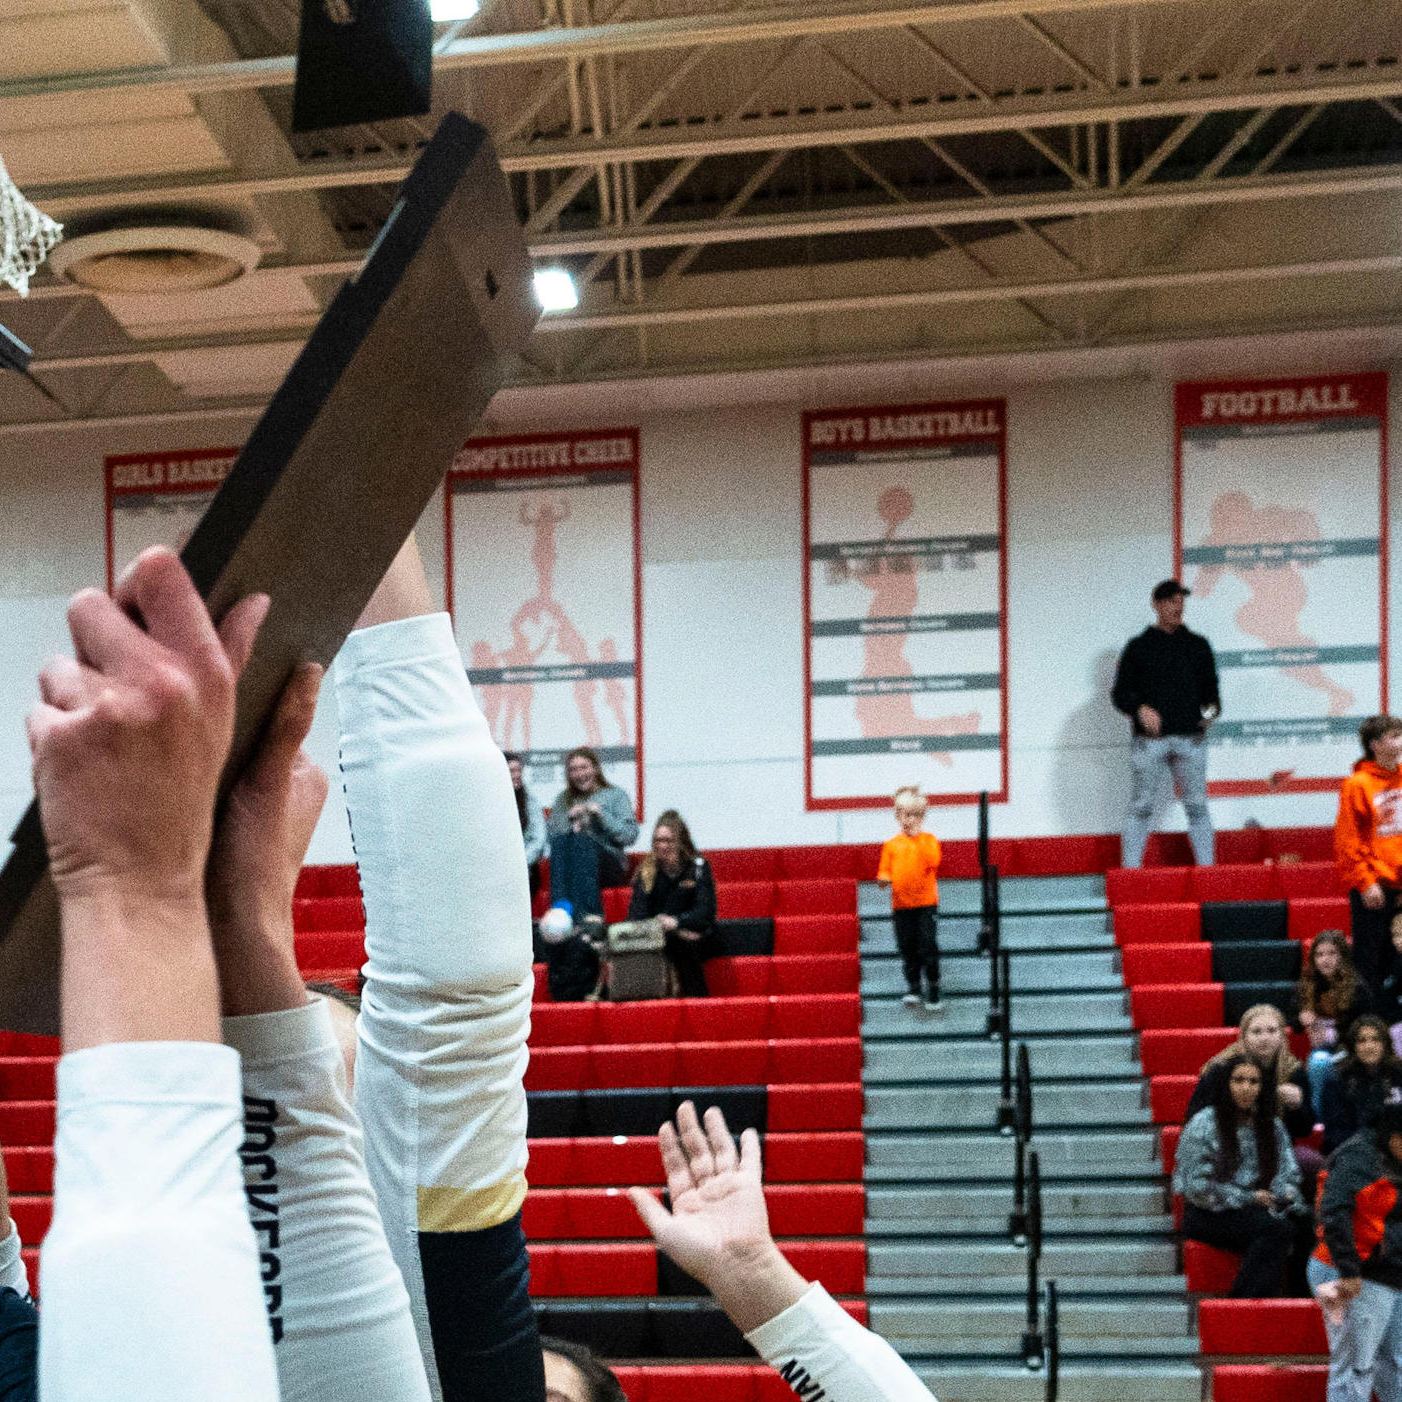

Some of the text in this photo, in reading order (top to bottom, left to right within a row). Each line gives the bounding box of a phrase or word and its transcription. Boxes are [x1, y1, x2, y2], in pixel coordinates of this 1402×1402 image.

[1201, 384, 1359, 419] FOOTBALL
[811, 410, 1000, 445] BOYS BASKETBALL
[238, 1095, 284, 1345] ROCKF
